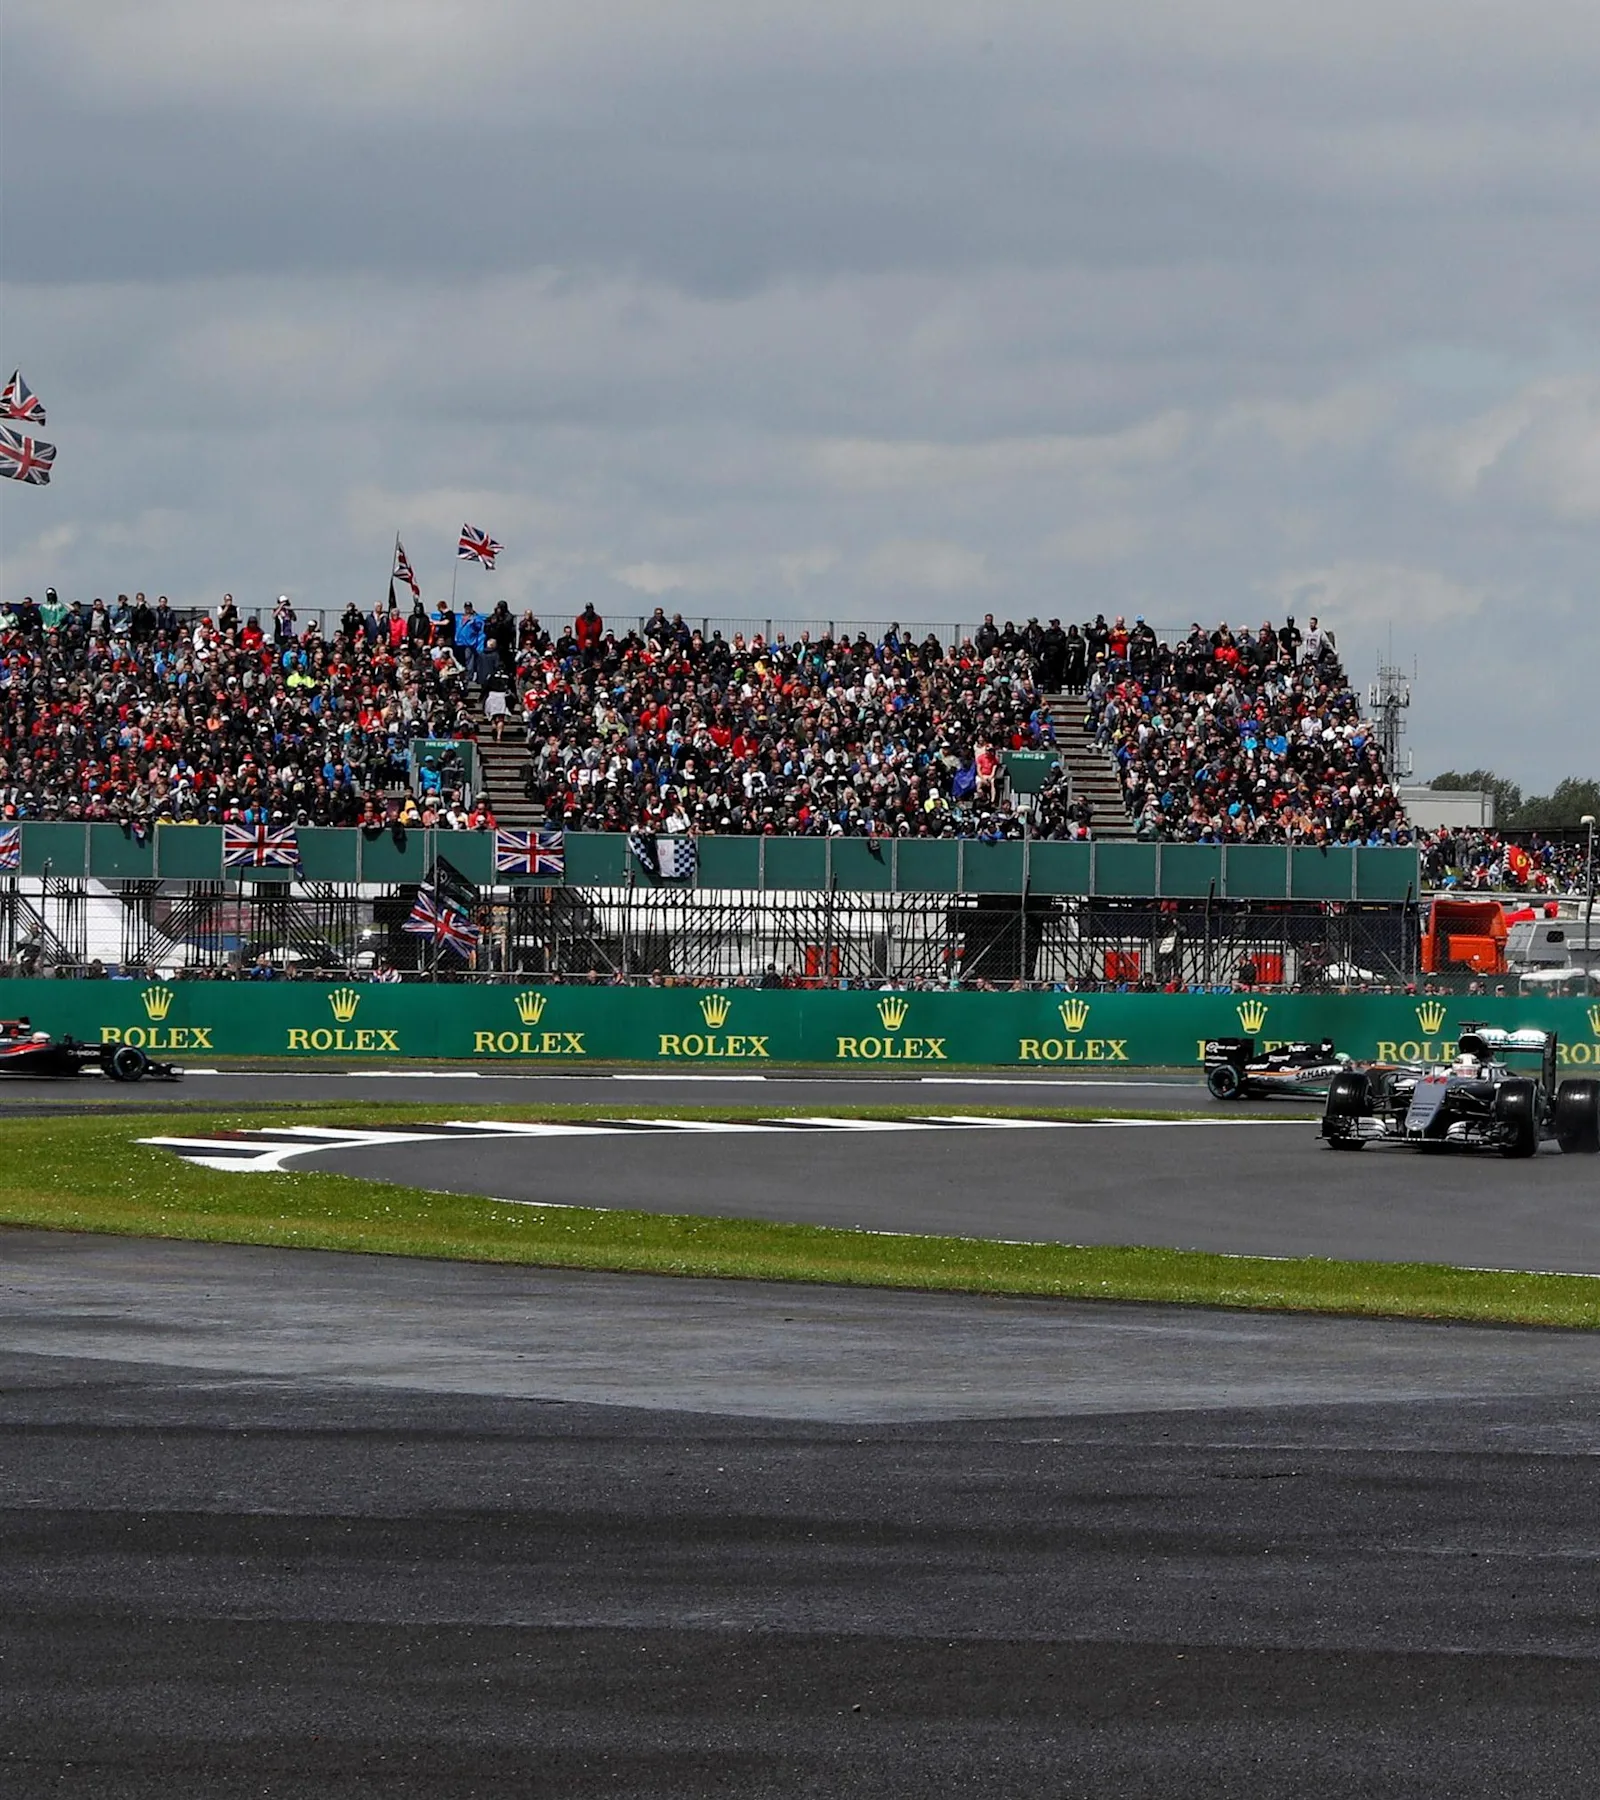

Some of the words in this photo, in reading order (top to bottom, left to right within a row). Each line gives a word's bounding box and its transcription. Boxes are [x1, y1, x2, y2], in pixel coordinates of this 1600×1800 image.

[100, 1027, 213, 1049] ROLEX
[287, 1028, 399, 1051] ROLEX
[473, 1031, 586, 1054] ROLEX
[658, 1034, 769, 1057] ROLEX
[836, 1037, 947, 1060] ROLEX
[1019, 1039, 1128, 1061] ROLEX
[1377, 1041, 1459, 1063] ROLE
